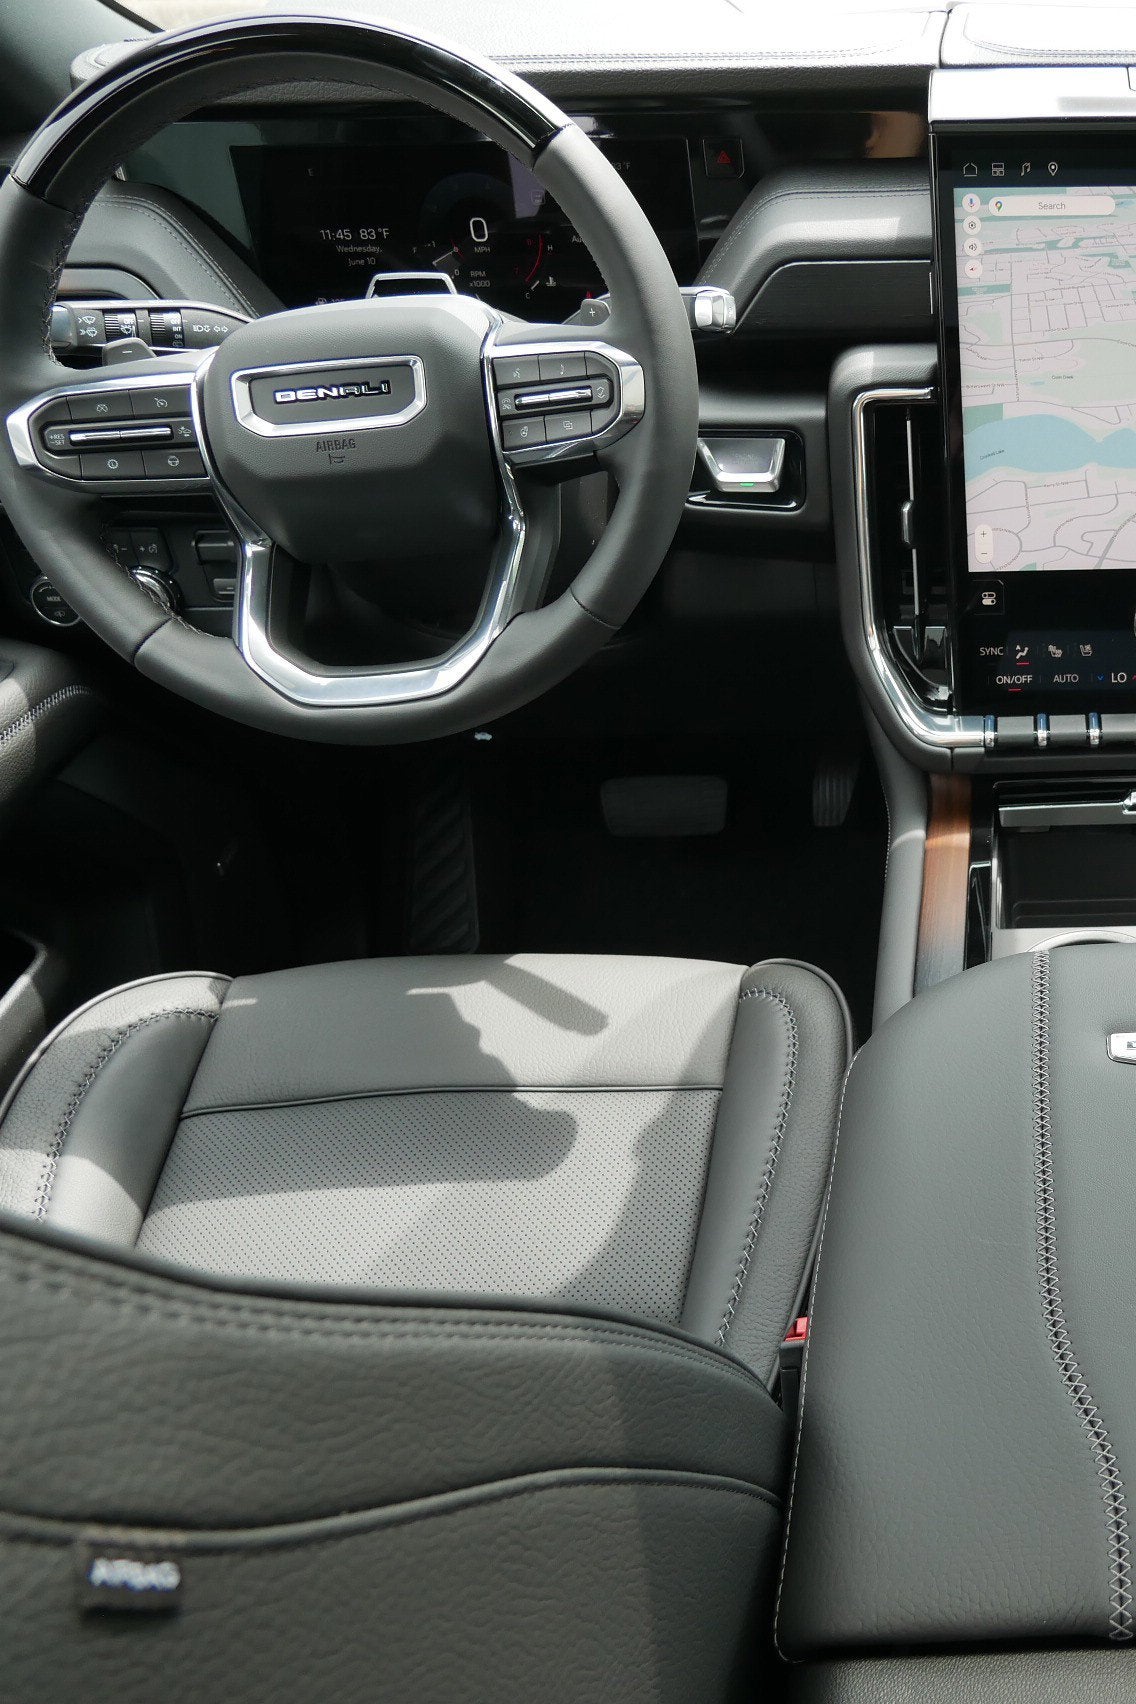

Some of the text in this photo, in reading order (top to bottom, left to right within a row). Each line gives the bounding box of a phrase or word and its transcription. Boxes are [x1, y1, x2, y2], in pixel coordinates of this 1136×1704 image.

[1037, 201, 1066, 211] Search
[319, 228, 353, 241] 11:45
[469, 217, 489, 243] 0
[347, 257, 365, 267] June
[274, 381, 390, 404] DENALI
[316, 438, 356, 453] AIRBAG
[979, 646, 1004, 656] SYNC
[996, 675, 1033, 685] ON/OFF
[1053, 674, 1079, 683] AUTO
[1111, 672, 1127, 683] LO
